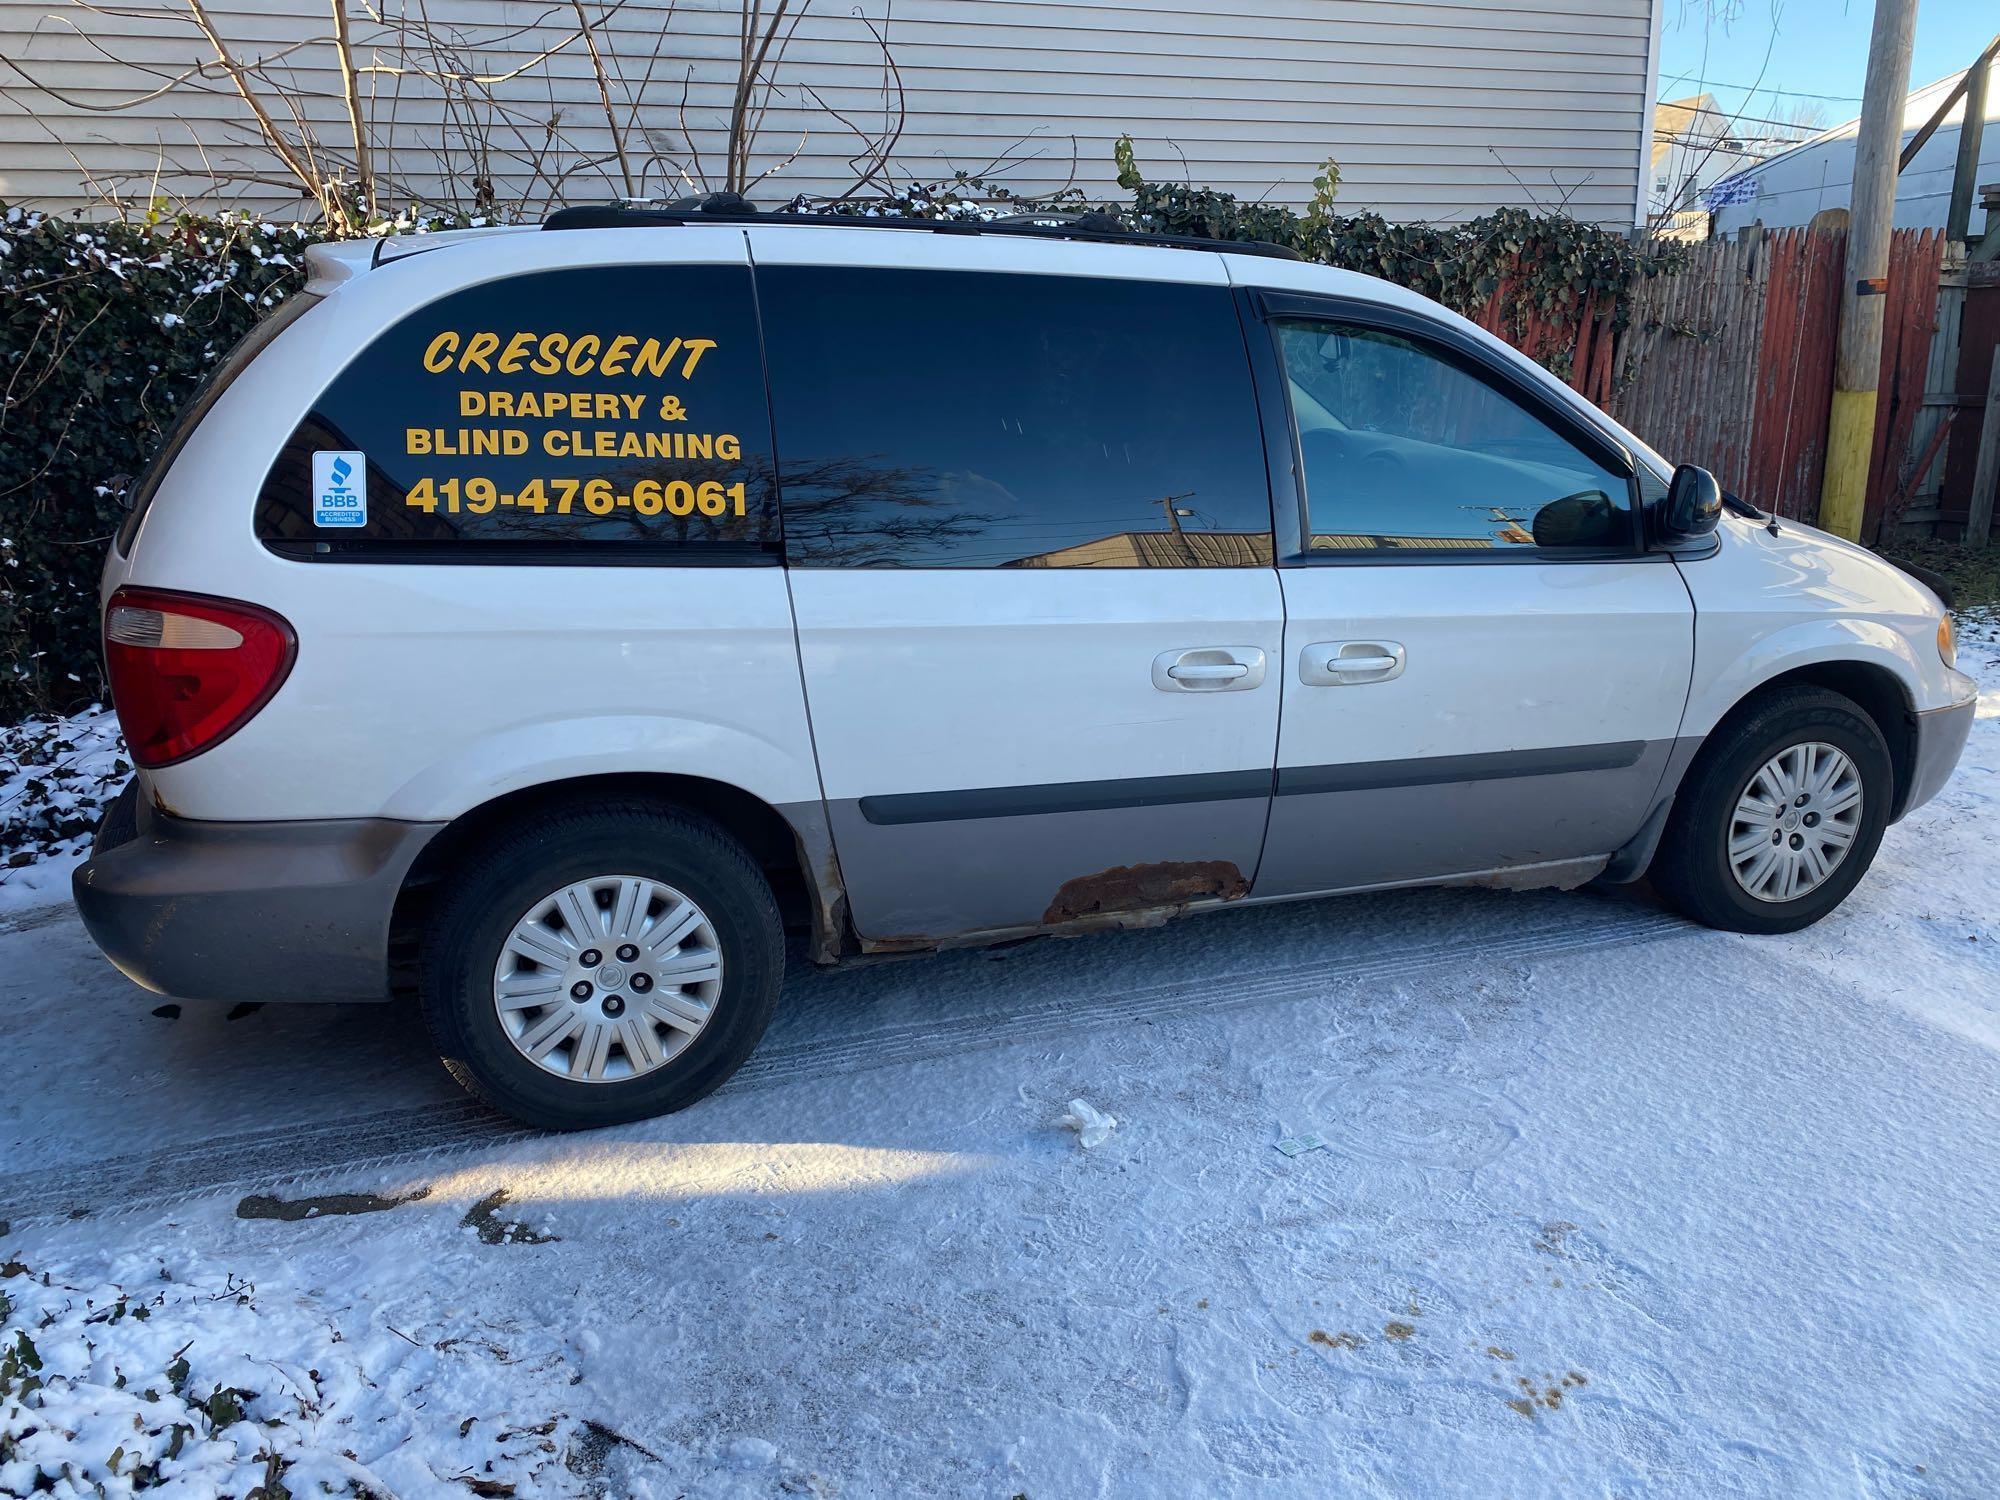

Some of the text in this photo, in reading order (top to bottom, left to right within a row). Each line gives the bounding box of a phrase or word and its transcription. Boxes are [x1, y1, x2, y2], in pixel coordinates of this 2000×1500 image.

[422, 331, 718, 381] CRESCENT
[460, 391, 688, 421] DRAPERY &
[406, 429, 741, 461] BLIND CLEANING
[322, 495, 358, 508] BBB
[405, 477, 746, 517] 419-476-6061
